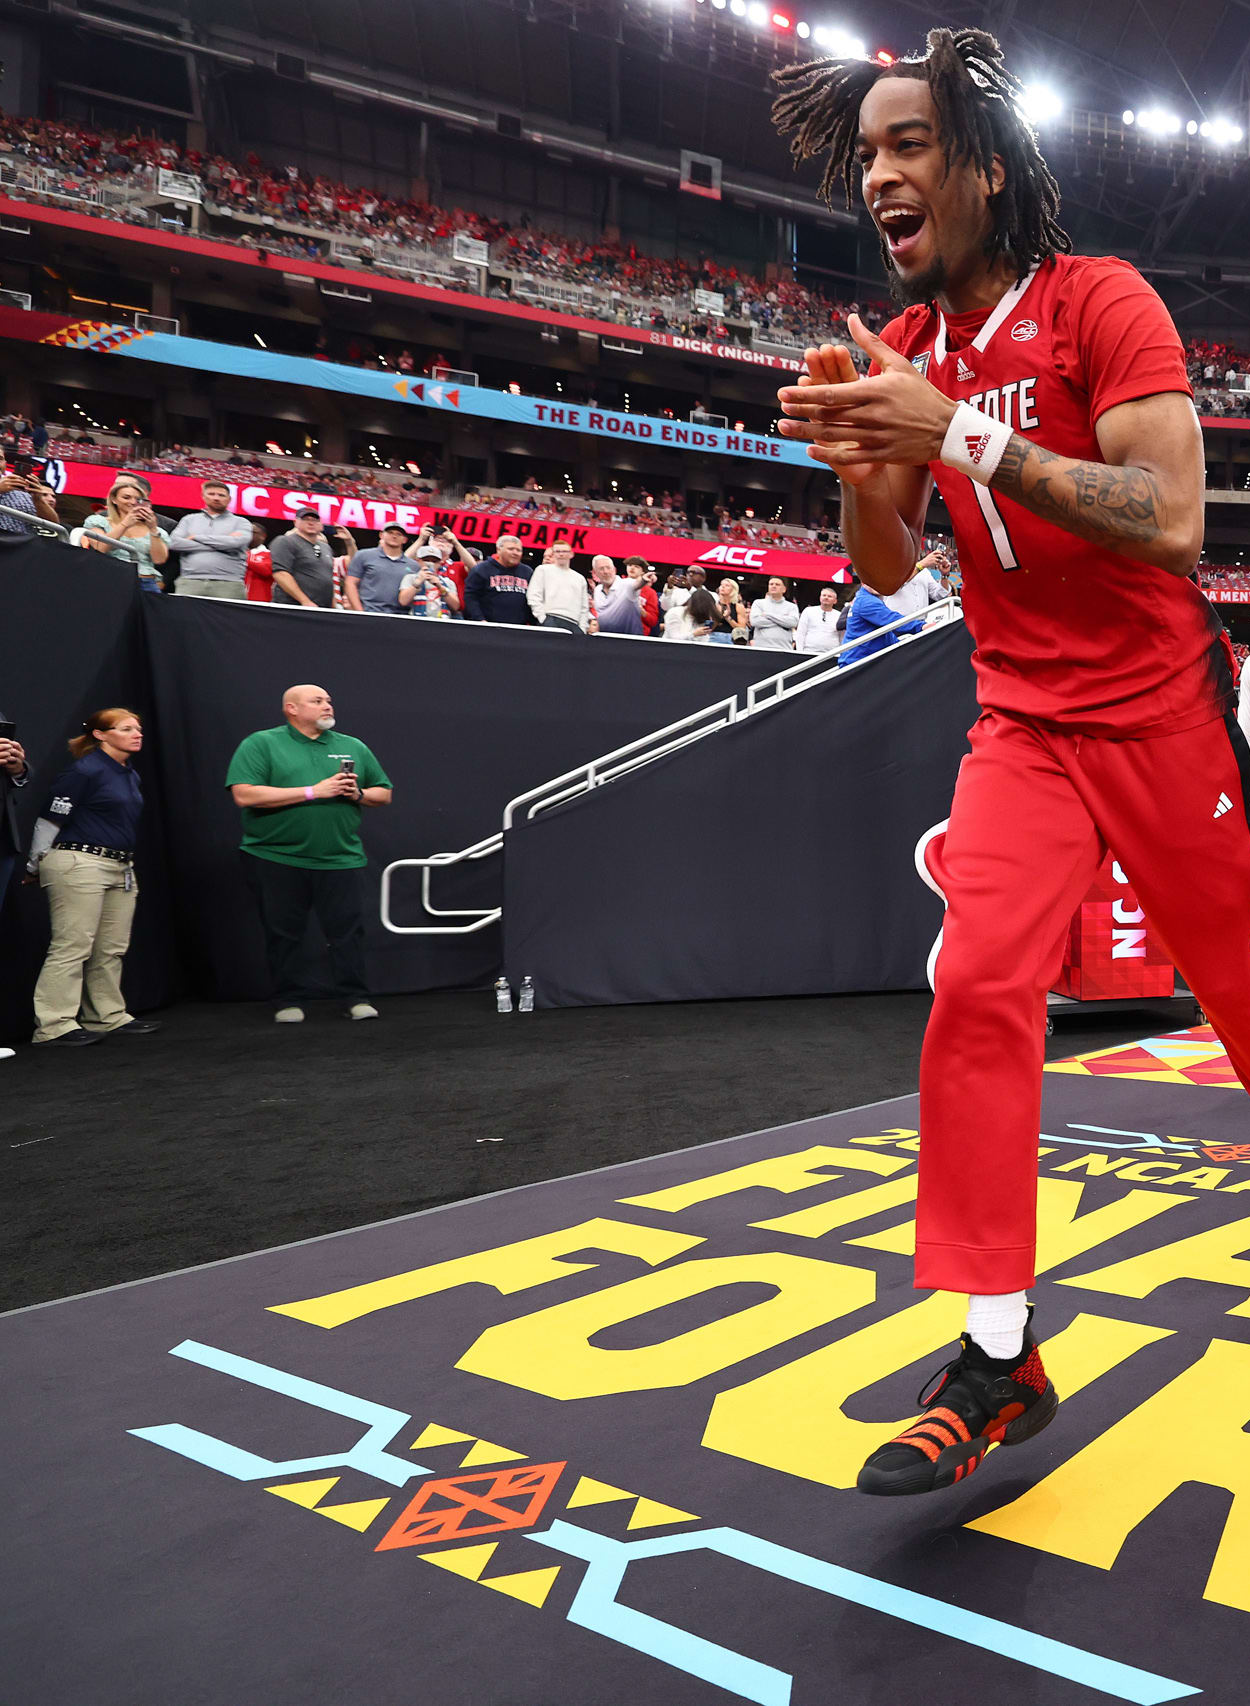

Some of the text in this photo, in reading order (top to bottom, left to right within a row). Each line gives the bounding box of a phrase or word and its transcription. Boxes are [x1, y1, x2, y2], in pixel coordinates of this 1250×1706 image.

[650, 332, 810, 373] 81 DICK (NIGHT TRA
[956, 376, 1040, 431] TATE
[534, 404, 782, 457] THE ROAD ENDS HERE
[973, 432, 992, 465] adidas
[282, 491, 421, 534] STATE
[697, 545, 768, 567] ACC
[1112, 897, 1147, 960] NC
